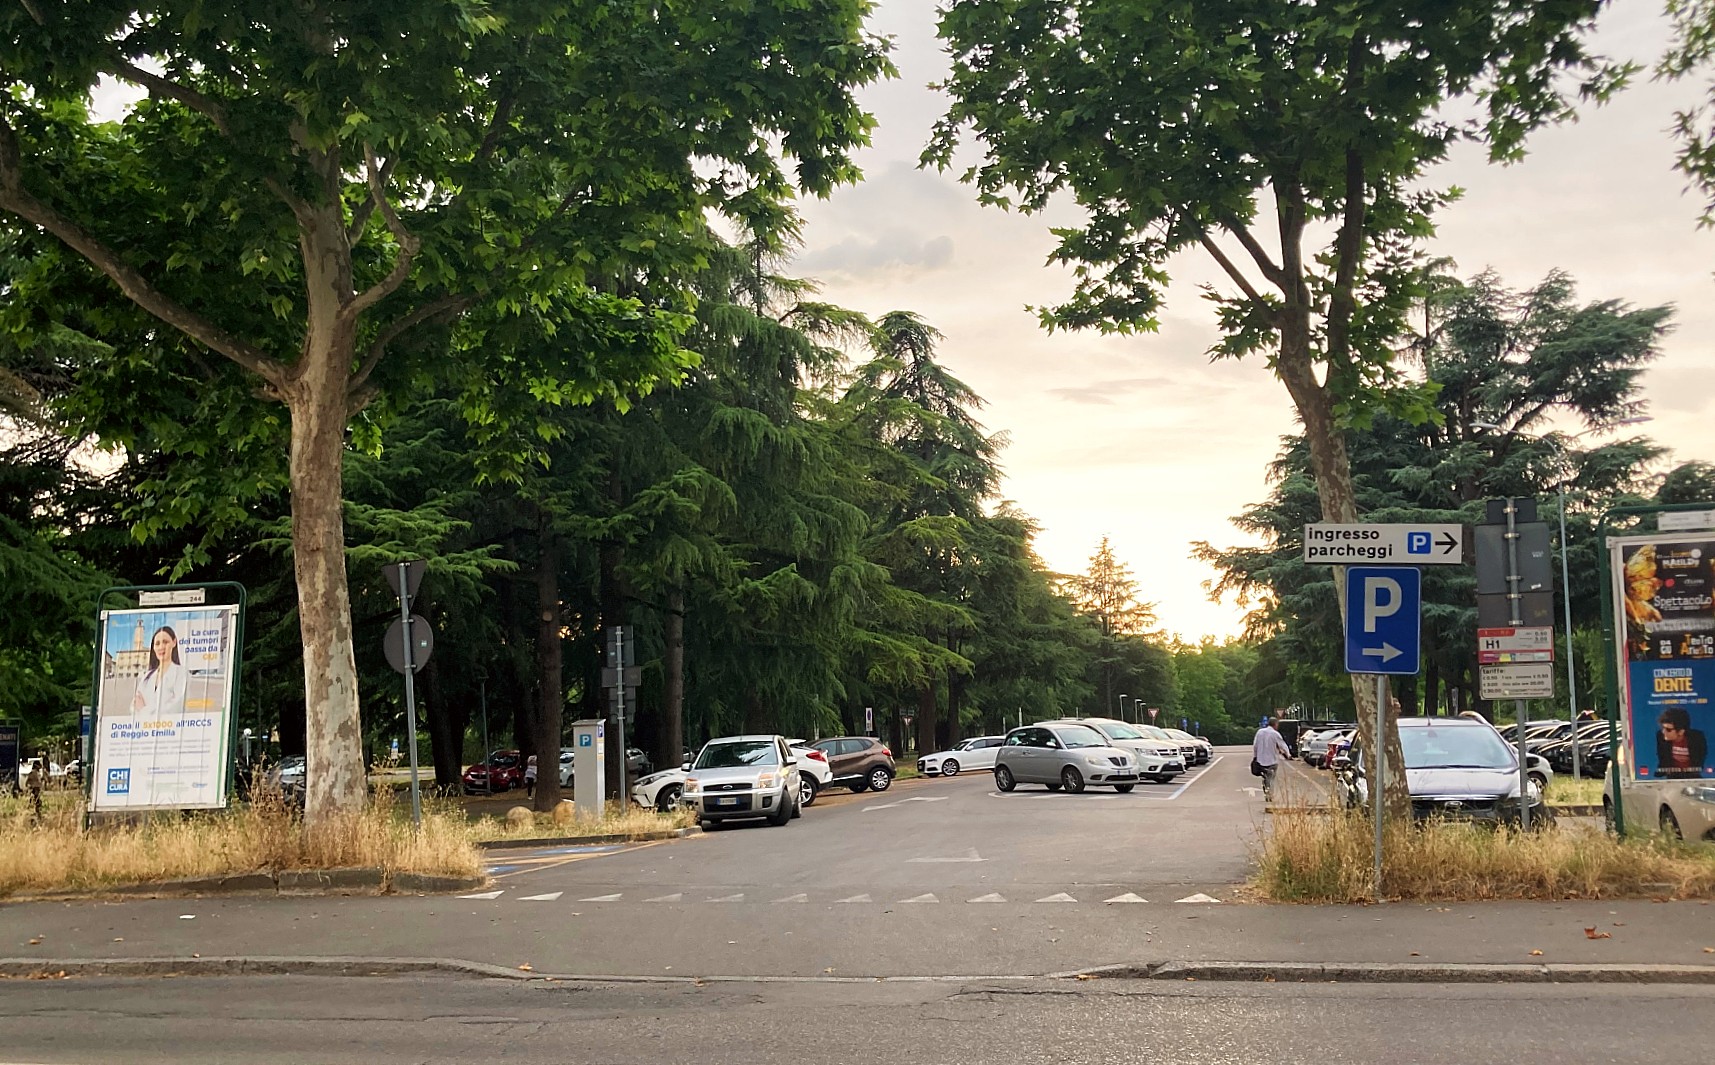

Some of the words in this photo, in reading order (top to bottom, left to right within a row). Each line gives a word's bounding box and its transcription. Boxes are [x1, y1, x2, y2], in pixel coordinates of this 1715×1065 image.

[1308, 527, 1380, 542] ingresso
[1308, 544, 1393, 558] parcheggi
[1364, 576, 1403, 633] P
[192, 637, 219, 645] tumori
[1486, 640, 1500, 649] H1
[1653, 677, 1693, 692] DENTE
[111, 722, 132, 730] Dona
[143, 721, 173, 729] 5x1000
[110, 731, 118, 739] di
[120, 730, 149, 740] Reggio
[151, 729, 176, 738] Emilia
[582, 735, 590, 746] P
[109, 771, 129, 780] CHI
